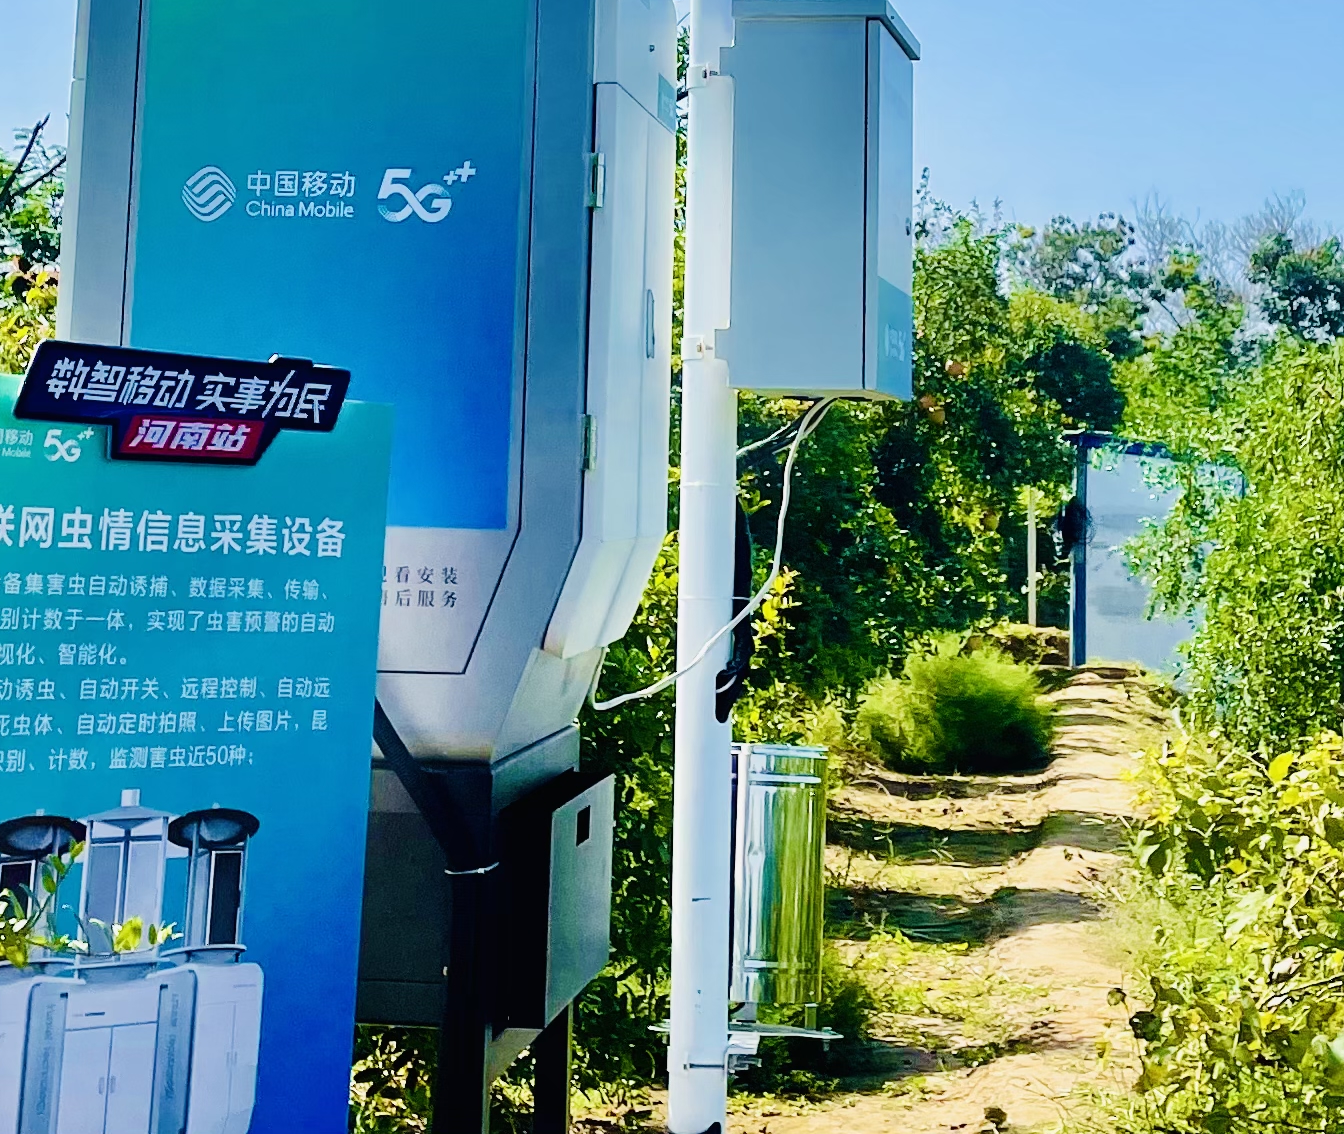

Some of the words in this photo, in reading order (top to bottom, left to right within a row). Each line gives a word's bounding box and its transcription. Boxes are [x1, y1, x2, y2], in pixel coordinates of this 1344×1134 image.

[247, 170, 355, 197] 中国移动
[245, 200, 294, 218] China
[299, 201, 354, 219] Mobile
[46, 357, 195, 410] 数智移动
[195, 370, 332, 424] 实事为民
[129, 419, 251, 452] 河南站
[2, 447, 32, 459] Mobile
[383, 565, 458, 585] 看安装
